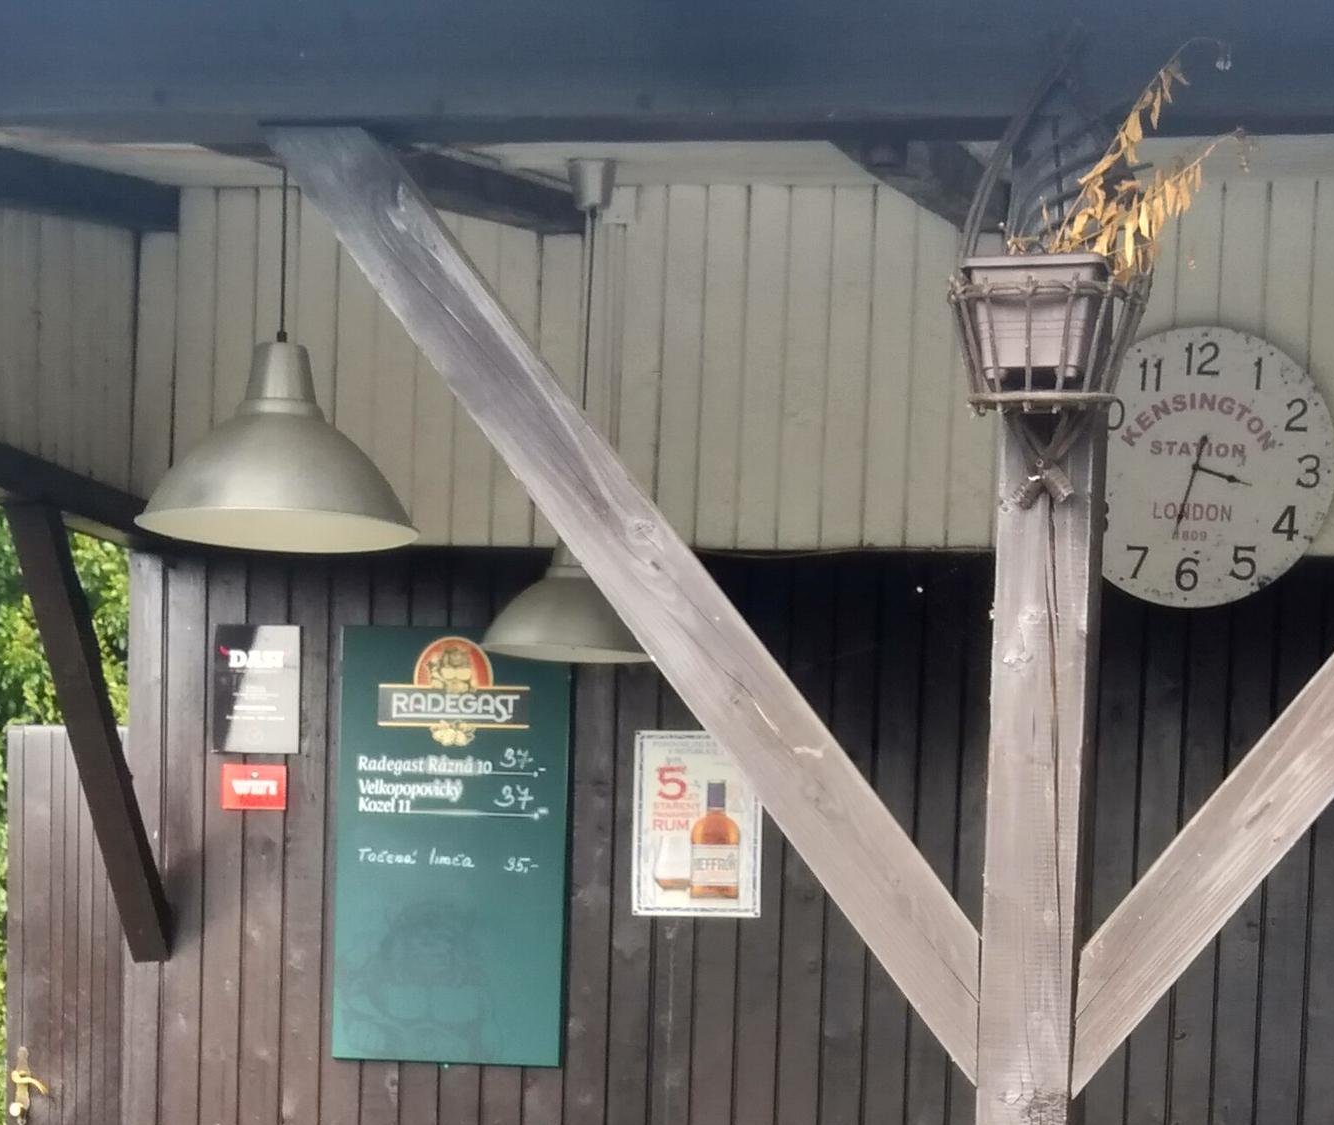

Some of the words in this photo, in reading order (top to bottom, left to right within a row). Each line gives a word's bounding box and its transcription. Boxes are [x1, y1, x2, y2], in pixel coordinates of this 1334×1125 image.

[1139, 358, 1163, 392] 11
[1185, 341, 1220, 376] 12
[1253, 357, 1263, 391] 1
[1120, 392, 1277, 452] KENSINGTON
[1284, 398, 1309, 432] 2
[1150, 440, 1246, 458] STATION
[1296, 454, 1321, 488] 3
[1153, 502, 1232, 522] LONDON
[1271, 505, 1299, 541] 4
[1126, 545, 1149, 579] 7
[1175, 558, 1200, 592] 6
[1228, 546, 1257, 580] 5
[392, 692, 520, 722] RADEGAST
[358, 755, 424, 775] Radegast
[477, 761, 493, 774] 10
[358, 779, 464, 802] Velkopopovický
[657, 765, 687, 801] 5
[358, 797, 395, 812] Kozel
[398, 799, 412, 813] 11
[652, 818, 689, 831] RUM
